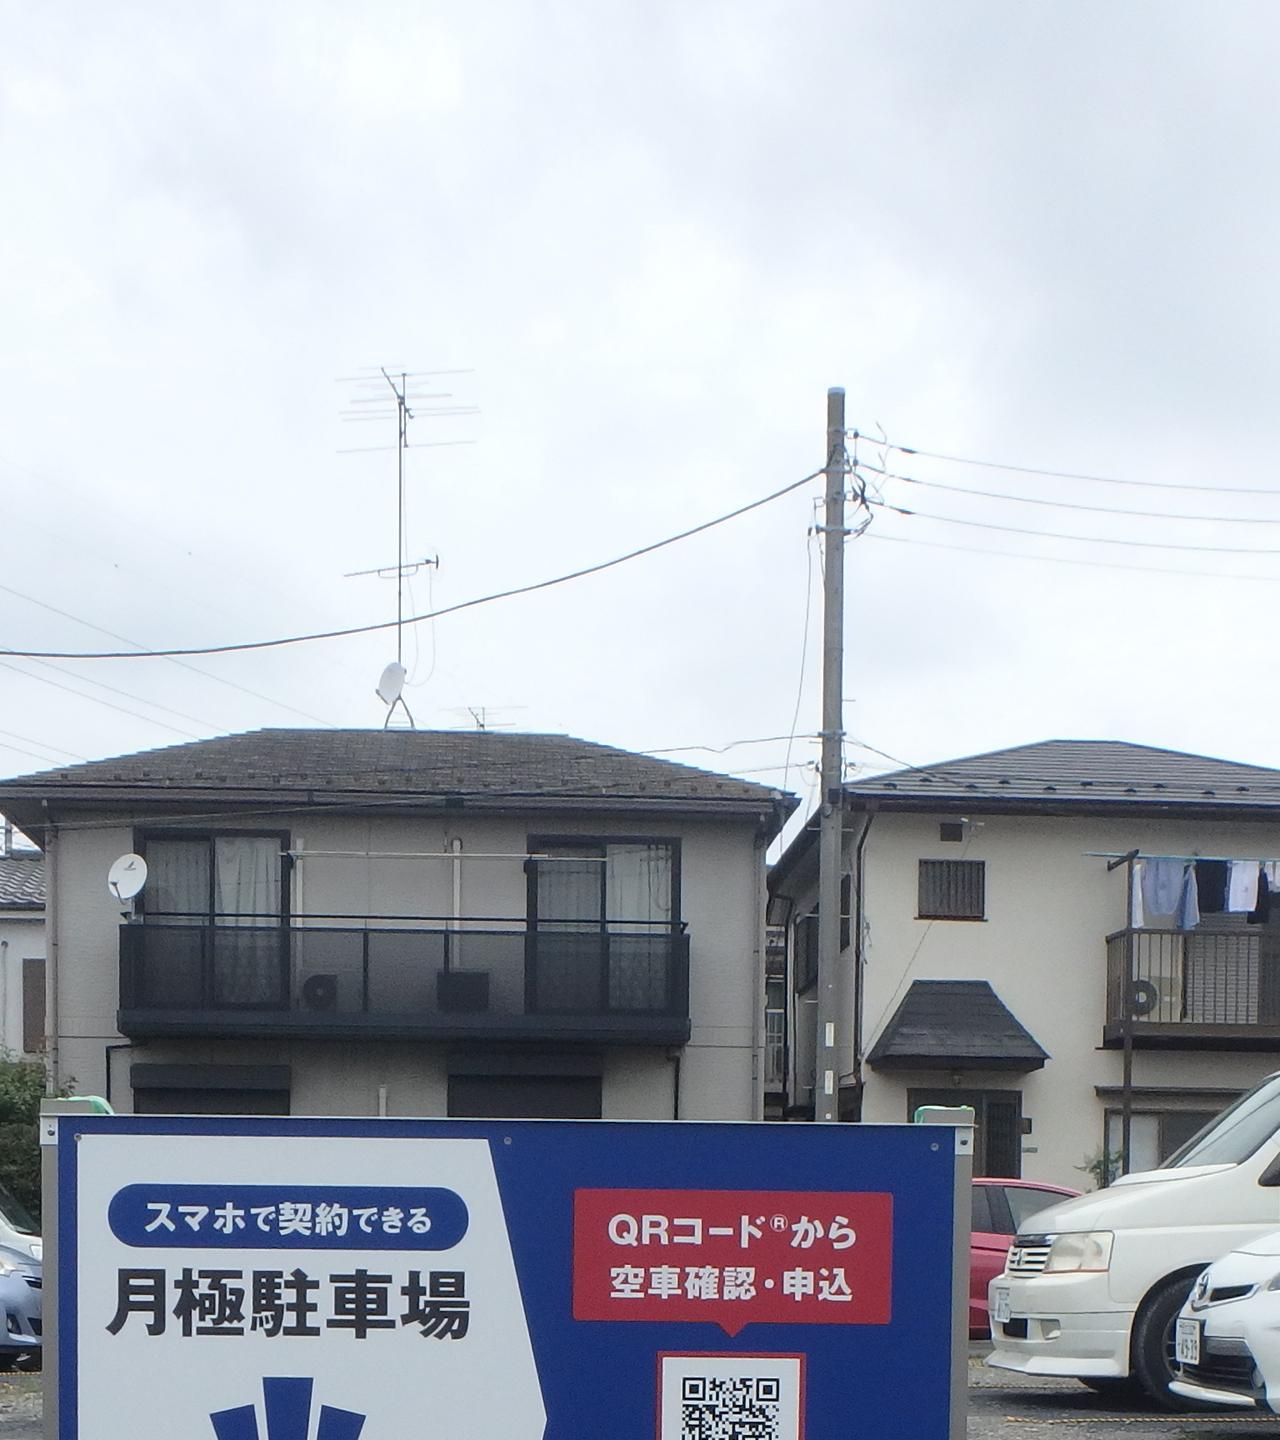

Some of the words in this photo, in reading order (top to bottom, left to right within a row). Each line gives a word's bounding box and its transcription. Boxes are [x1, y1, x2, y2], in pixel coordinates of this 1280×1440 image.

[144, 1201, 432, 1237] スマホで契約できる
[609, 1264, 854, 1302] 空車確認・申込
[105, 1267, 471, 1340] 月極駐車場
